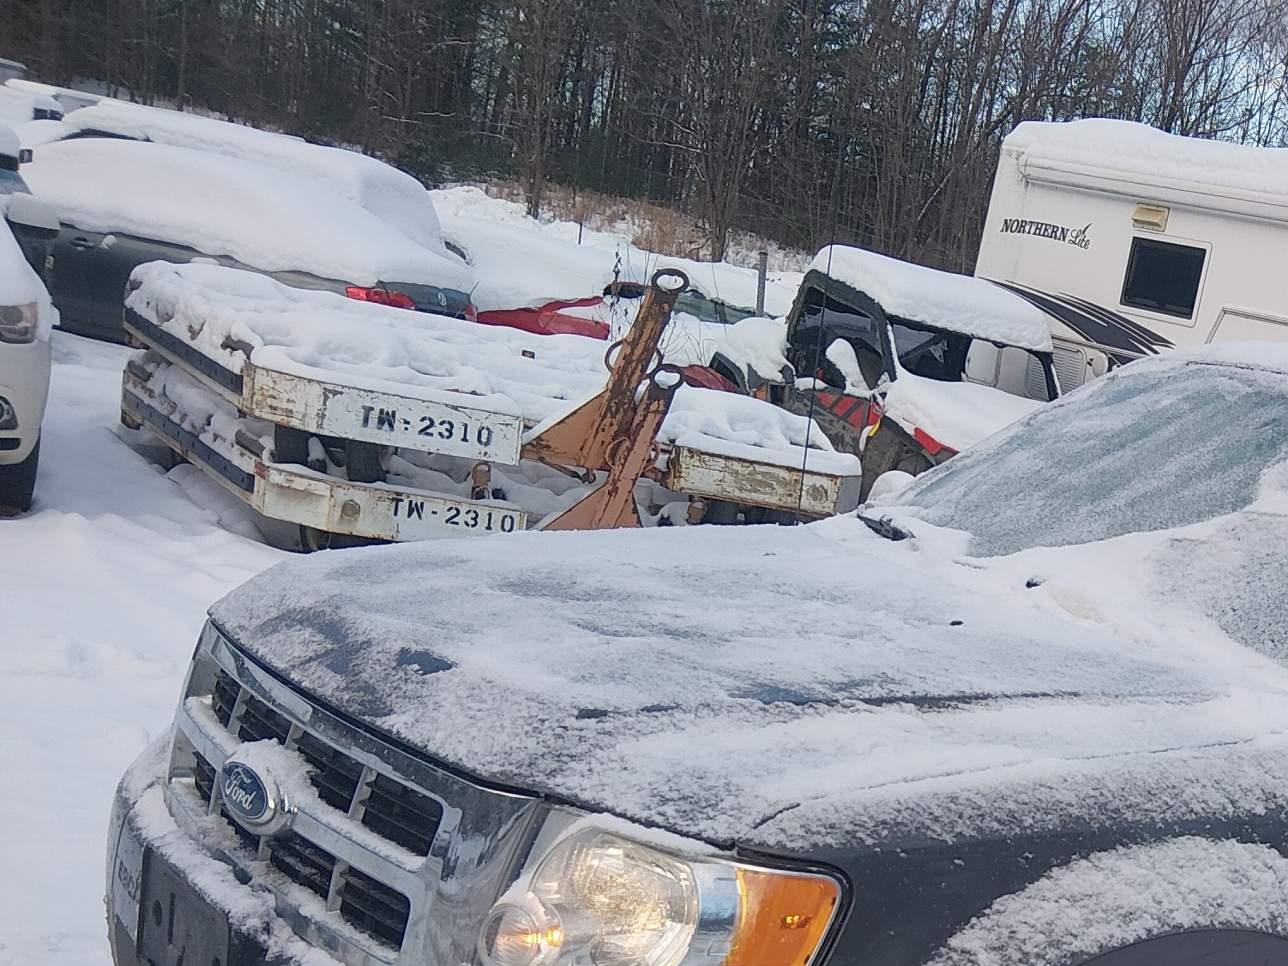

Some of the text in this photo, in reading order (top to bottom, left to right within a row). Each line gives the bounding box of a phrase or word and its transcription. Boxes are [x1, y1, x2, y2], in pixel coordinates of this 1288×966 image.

[1000, 218, 1092, 250] NORTHERN Lite
[225, 767, 258, 811] Ford
